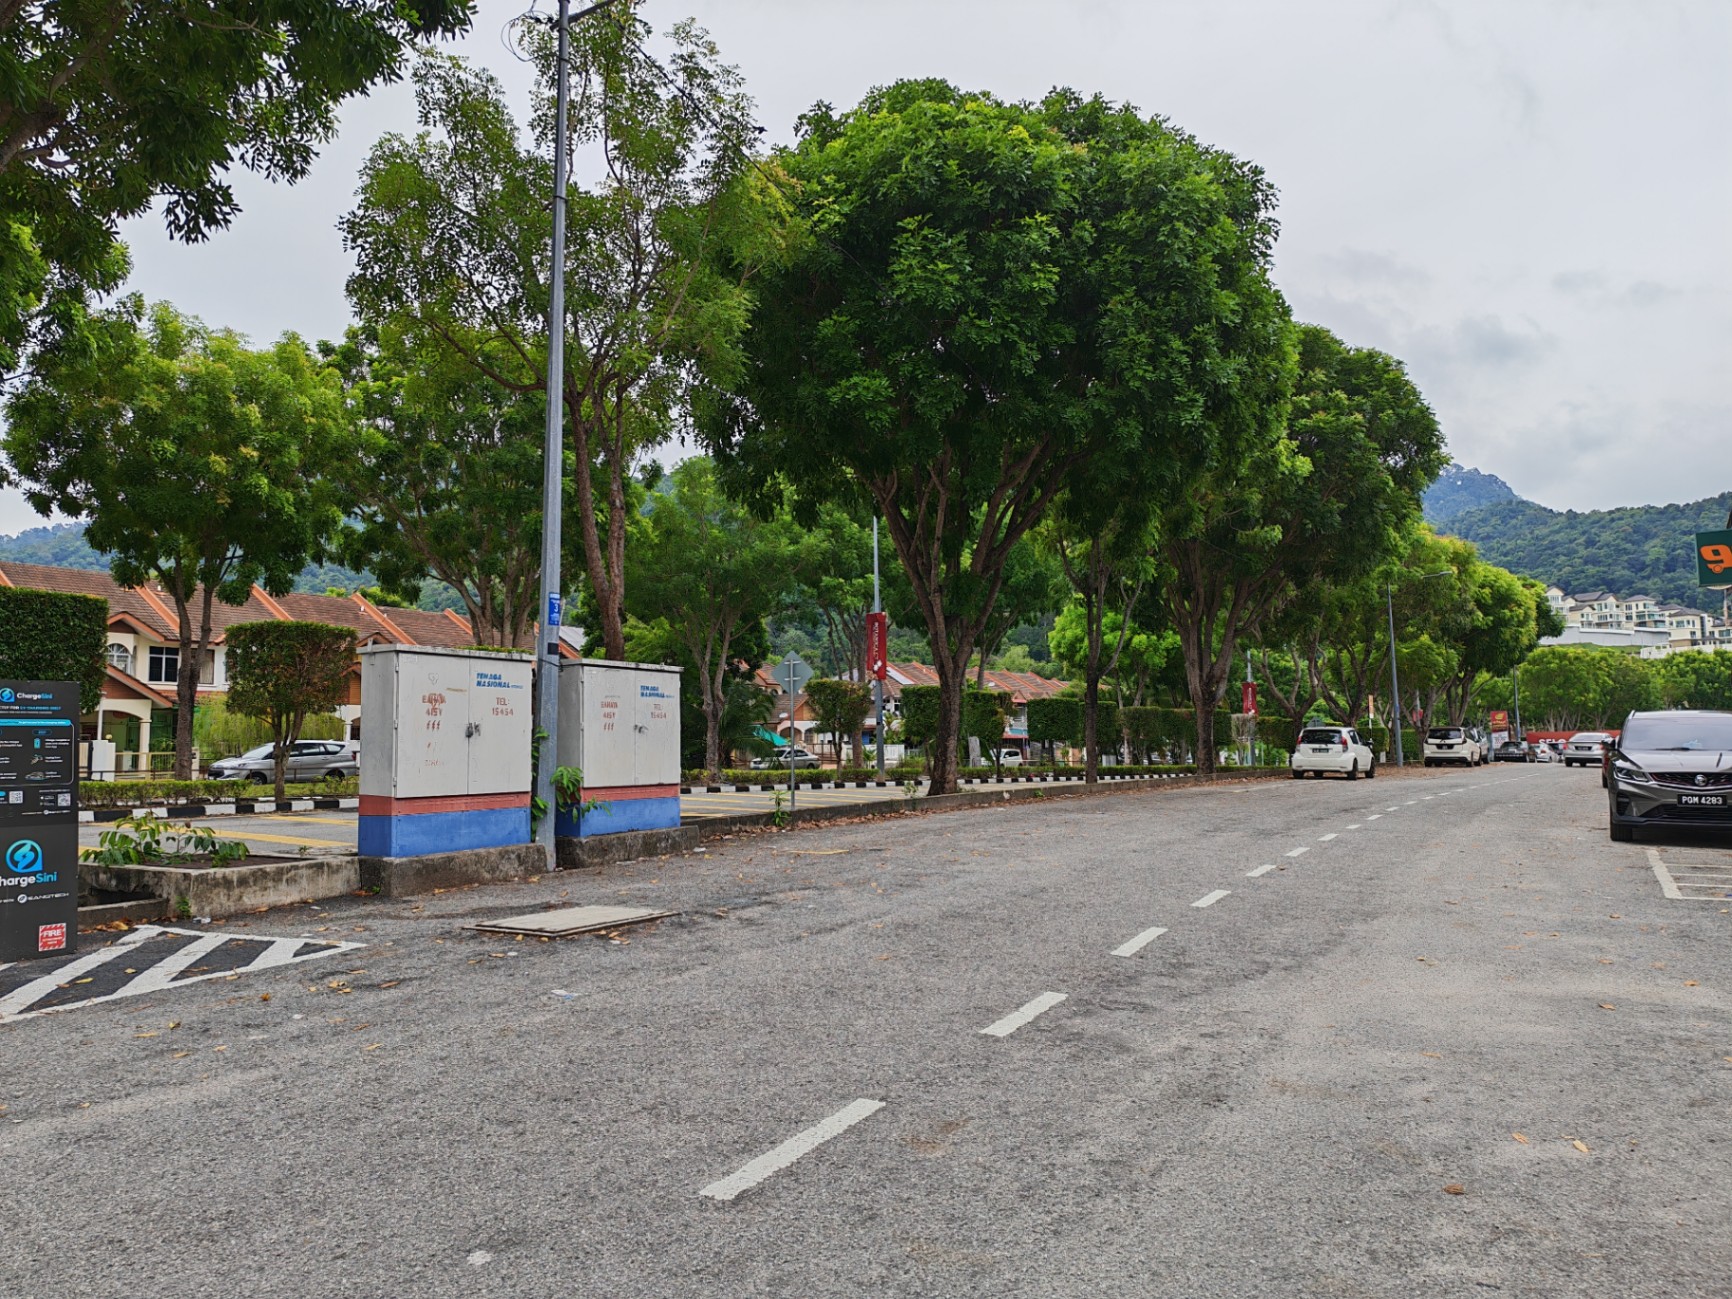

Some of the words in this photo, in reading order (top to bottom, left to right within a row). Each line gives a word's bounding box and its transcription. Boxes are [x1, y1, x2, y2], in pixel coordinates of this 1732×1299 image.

[476, 680, 510, 688] NASIONAL
[492, 707, 514, 716] 15454
[1700, 796, 1723, 805] 4283
[0, 872, 57, 887] hargeSini
[43, 929, 62, 937] FIRE
